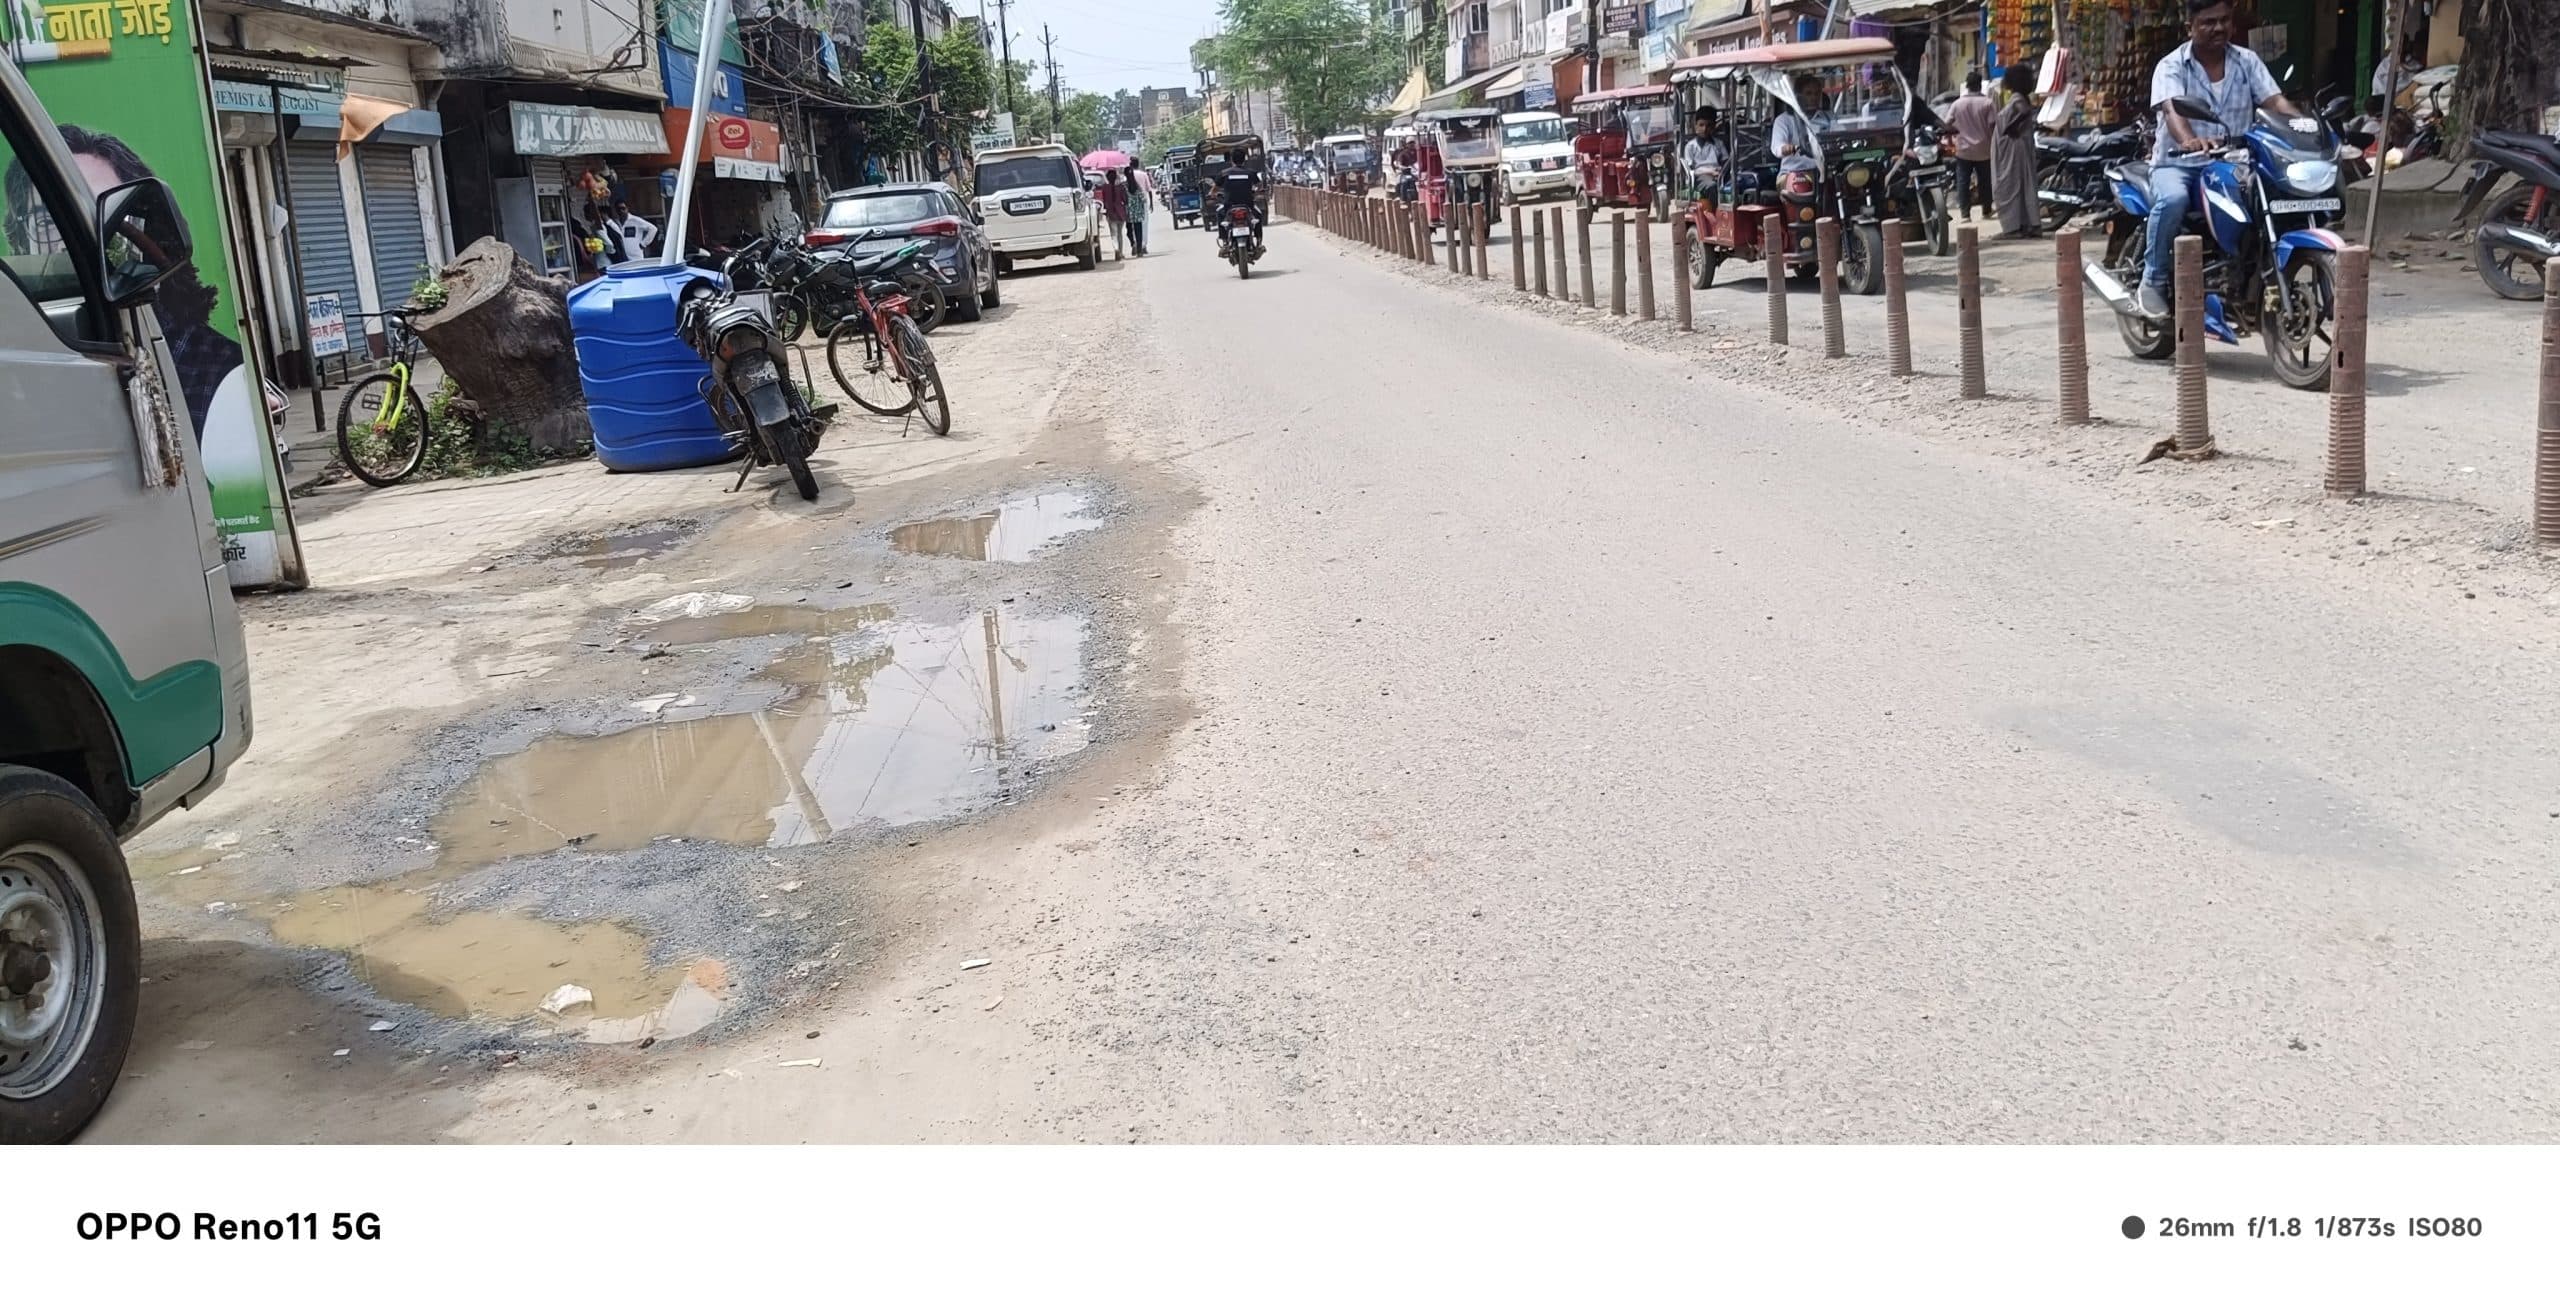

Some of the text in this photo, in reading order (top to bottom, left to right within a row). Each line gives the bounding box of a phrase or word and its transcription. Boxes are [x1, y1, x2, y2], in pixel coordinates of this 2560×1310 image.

[44, 2, 112, 41] नाता
[1744, 29, 1787, 51] Ageies
[215, 90, 255, 107] HEMIST
[269, 95, 320, 111] UGGIST
[540, 114, 656, 142] KITAB MAHAL
[222, 546, 247, 563] कार
